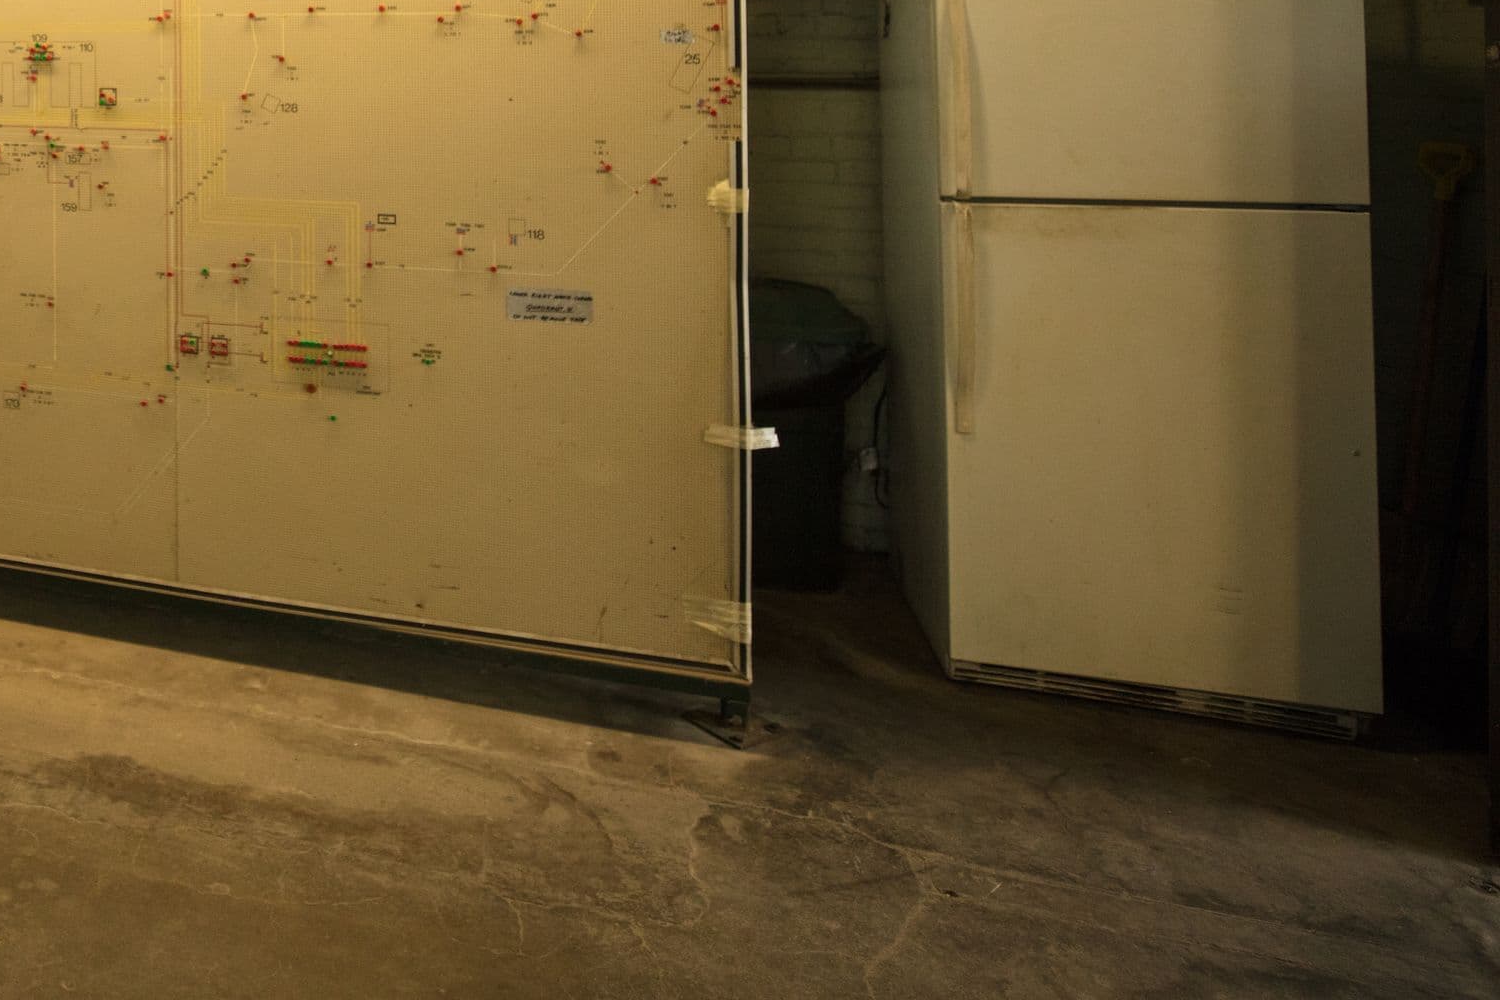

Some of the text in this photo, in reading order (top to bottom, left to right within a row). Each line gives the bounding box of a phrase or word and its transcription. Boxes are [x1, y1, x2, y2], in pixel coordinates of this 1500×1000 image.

[31, 33, 48, 43] 109
[79, 43, 94, 53] 110
[280, 102, 299, 113] 128
[61, 202, 78, 213] 159
[526, 228, 546, 240] 118
